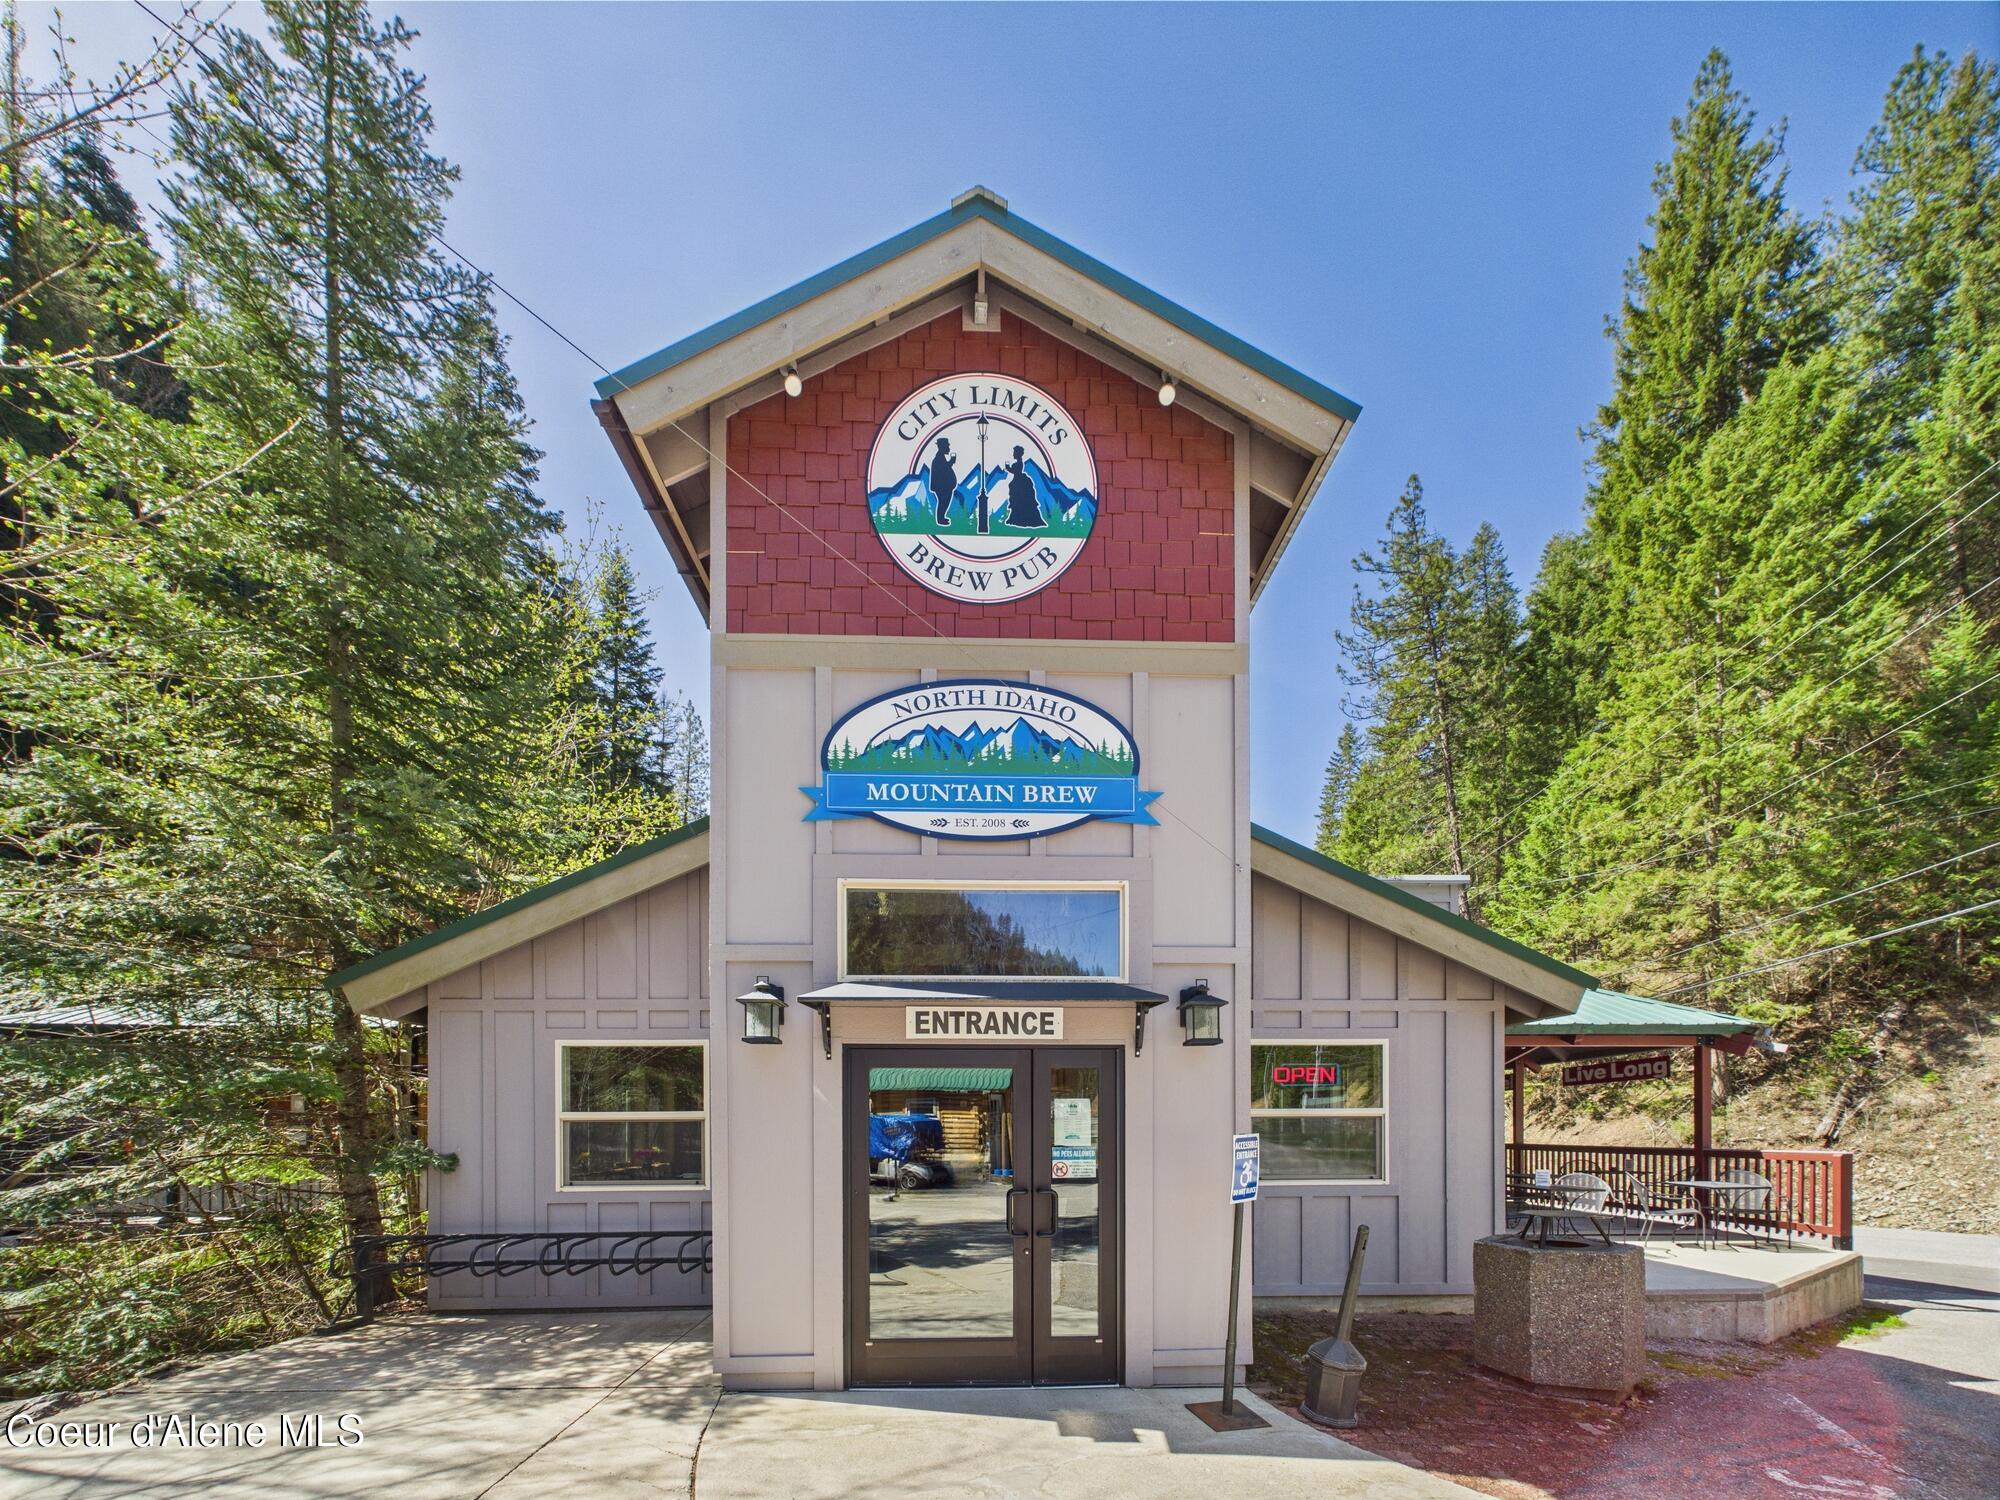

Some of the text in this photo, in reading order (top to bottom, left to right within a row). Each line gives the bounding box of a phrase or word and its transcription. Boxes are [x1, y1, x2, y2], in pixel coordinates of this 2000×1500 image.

[898, 386, 1067, 445] CITY LIMITS
[906, 542, 1058, 591] BREW PUB
[891, 689, 1077, 723] NORTH IDAHO
[866, 782, 1098, 803] MOUNTAIN BREW
[955, 817, 1006, 828] EST. 2008
[915, 1011, 1055, 1035] ENTRANCE
[1273, 1066, 1335, 1083] OPEN
[1564, 1060, 1668, 1082] Live Long
